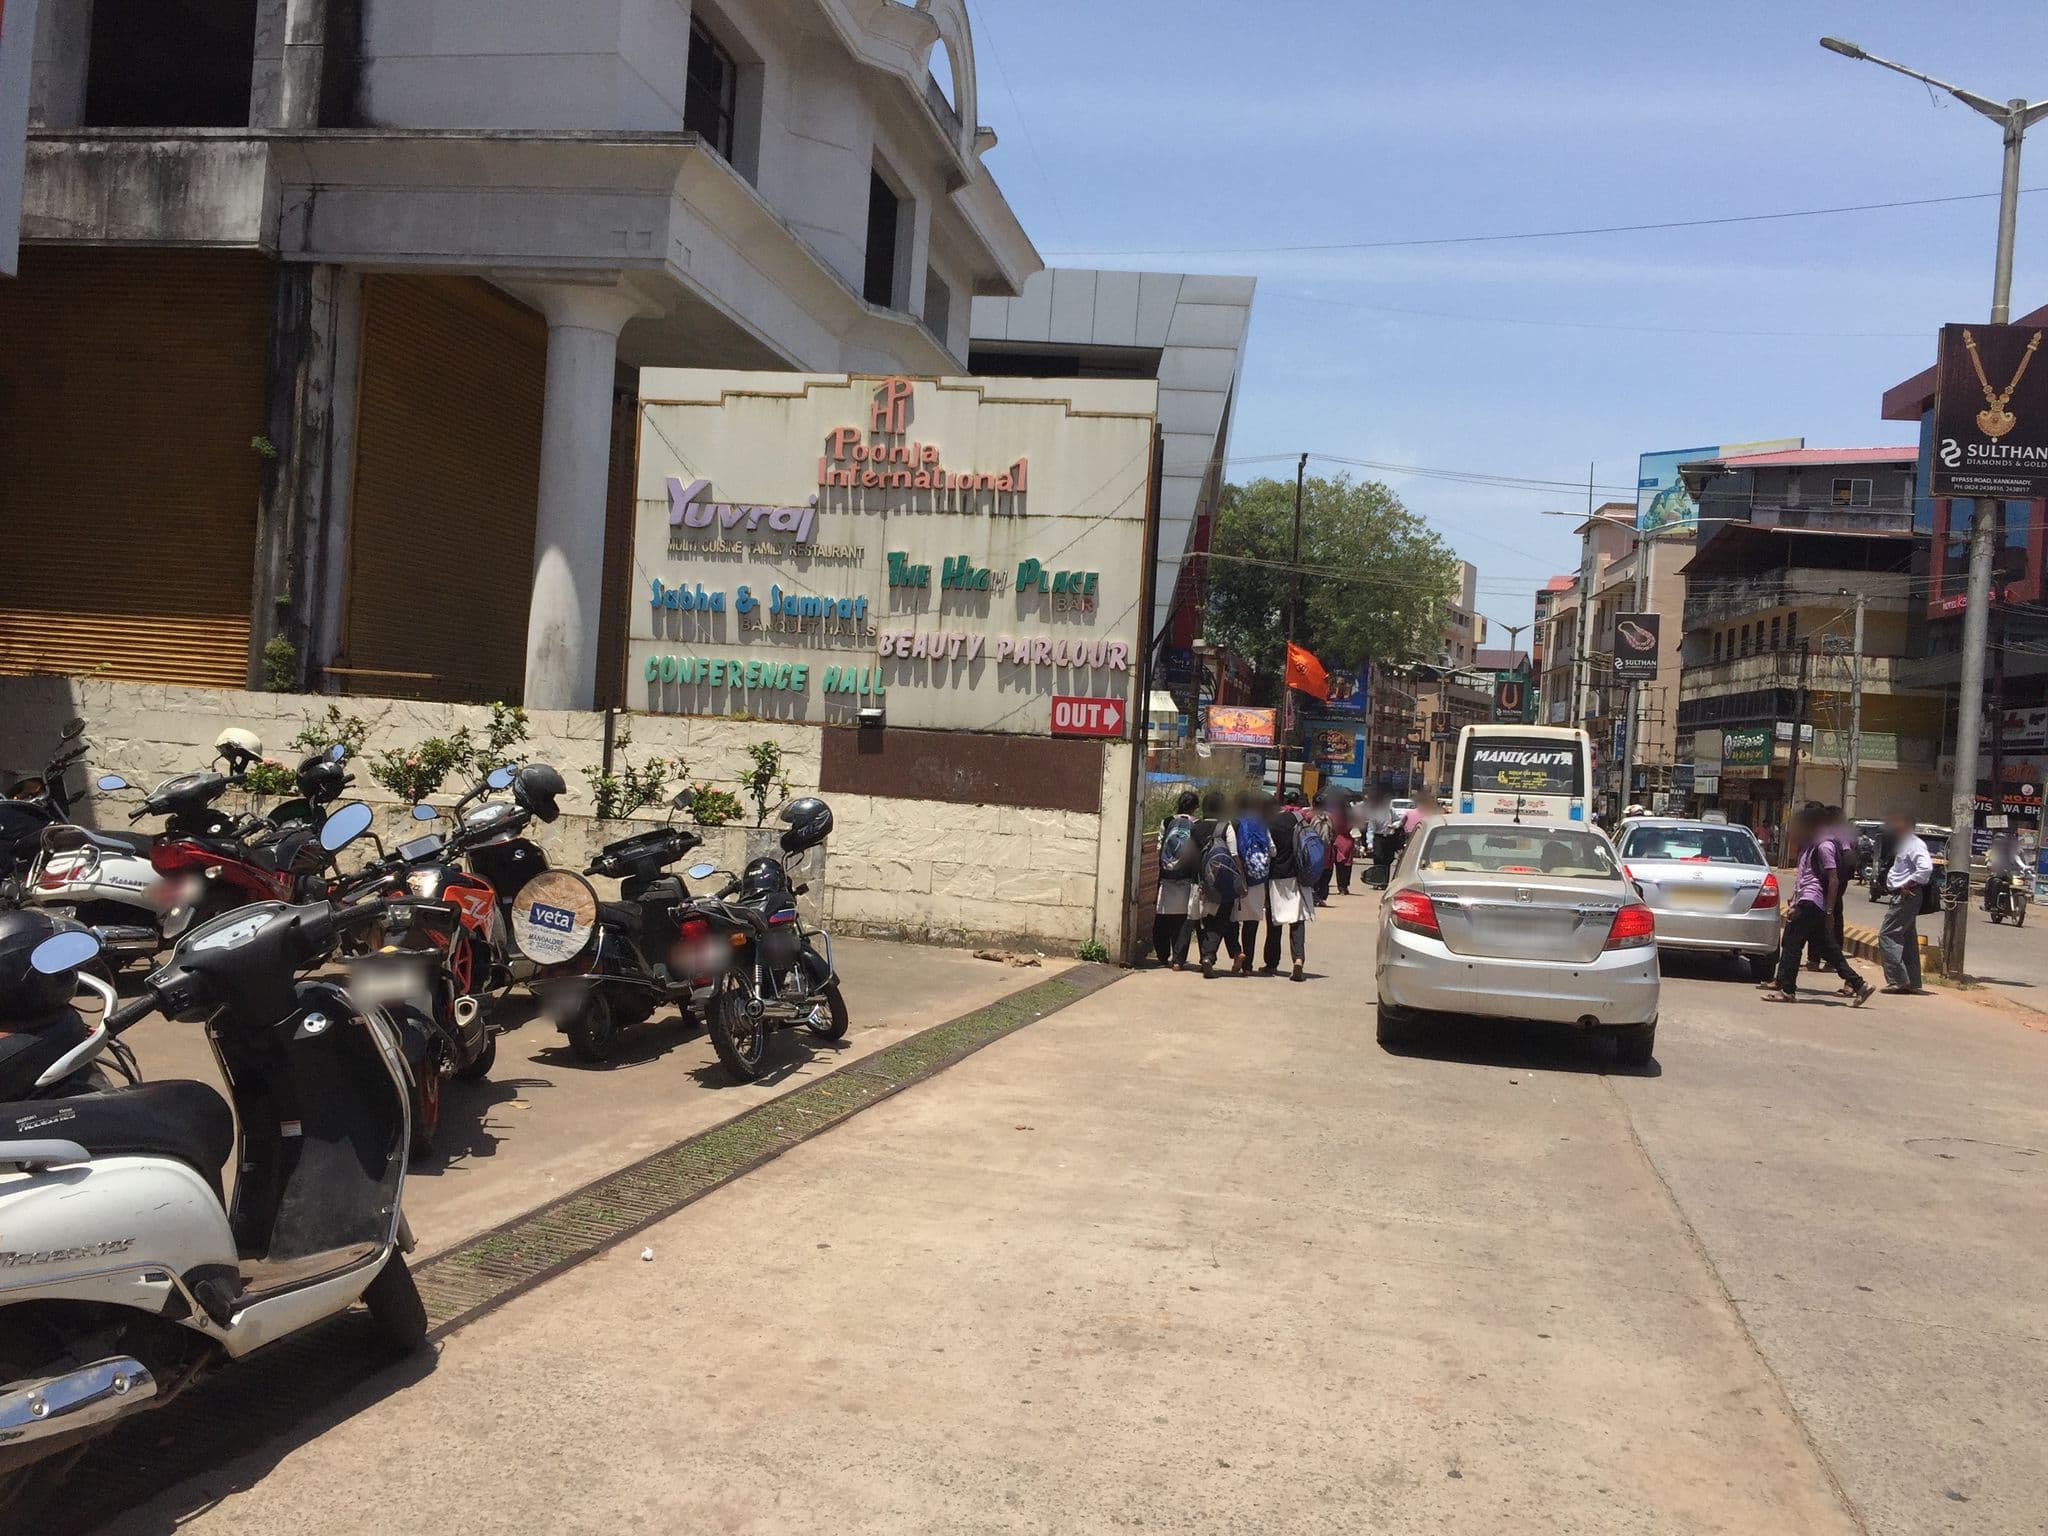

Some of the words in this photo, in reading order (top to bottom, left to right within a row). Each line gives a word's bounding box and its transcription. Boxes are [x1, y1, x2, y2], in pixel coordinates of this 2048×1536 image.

[825, 427, 939, 468] Poonja
[1967, 443, 2048, 460] SULTHAN
[818, 456, 1028, 493] International
[1966, 458, 2013, 467] DIAMONDS
[2024, 460, 2048, 468] GOLD
[666, 477, 818, 543] Yuvraj
[702, 539, 743, 554] CUISINE
[749, 541, 783, 556] FAMILY
[789, 543, 865, 560] RESTAURANT
[650, 578, 726, 613] Sabha
[735, 585, 760, 614] &
[769, 583, 868, 620] Samrat
[1056, 597, 1094, 614] BAR
[741, 617, 818, 634] BANQUET
[824, 621, 878, 638] HALLS
[878, 630, 987, 662] BEAUTY
[996, 635, 1129, 672] PARLOUR
[644, 655, 810, 692] CONFERENCE
[822, 663, 887, 695] HALL
[1055, 702, 1102, 728] OUT
[1473, 750, 1574, 766] MANIKANTA
[535, 908, 570, 928] veta
